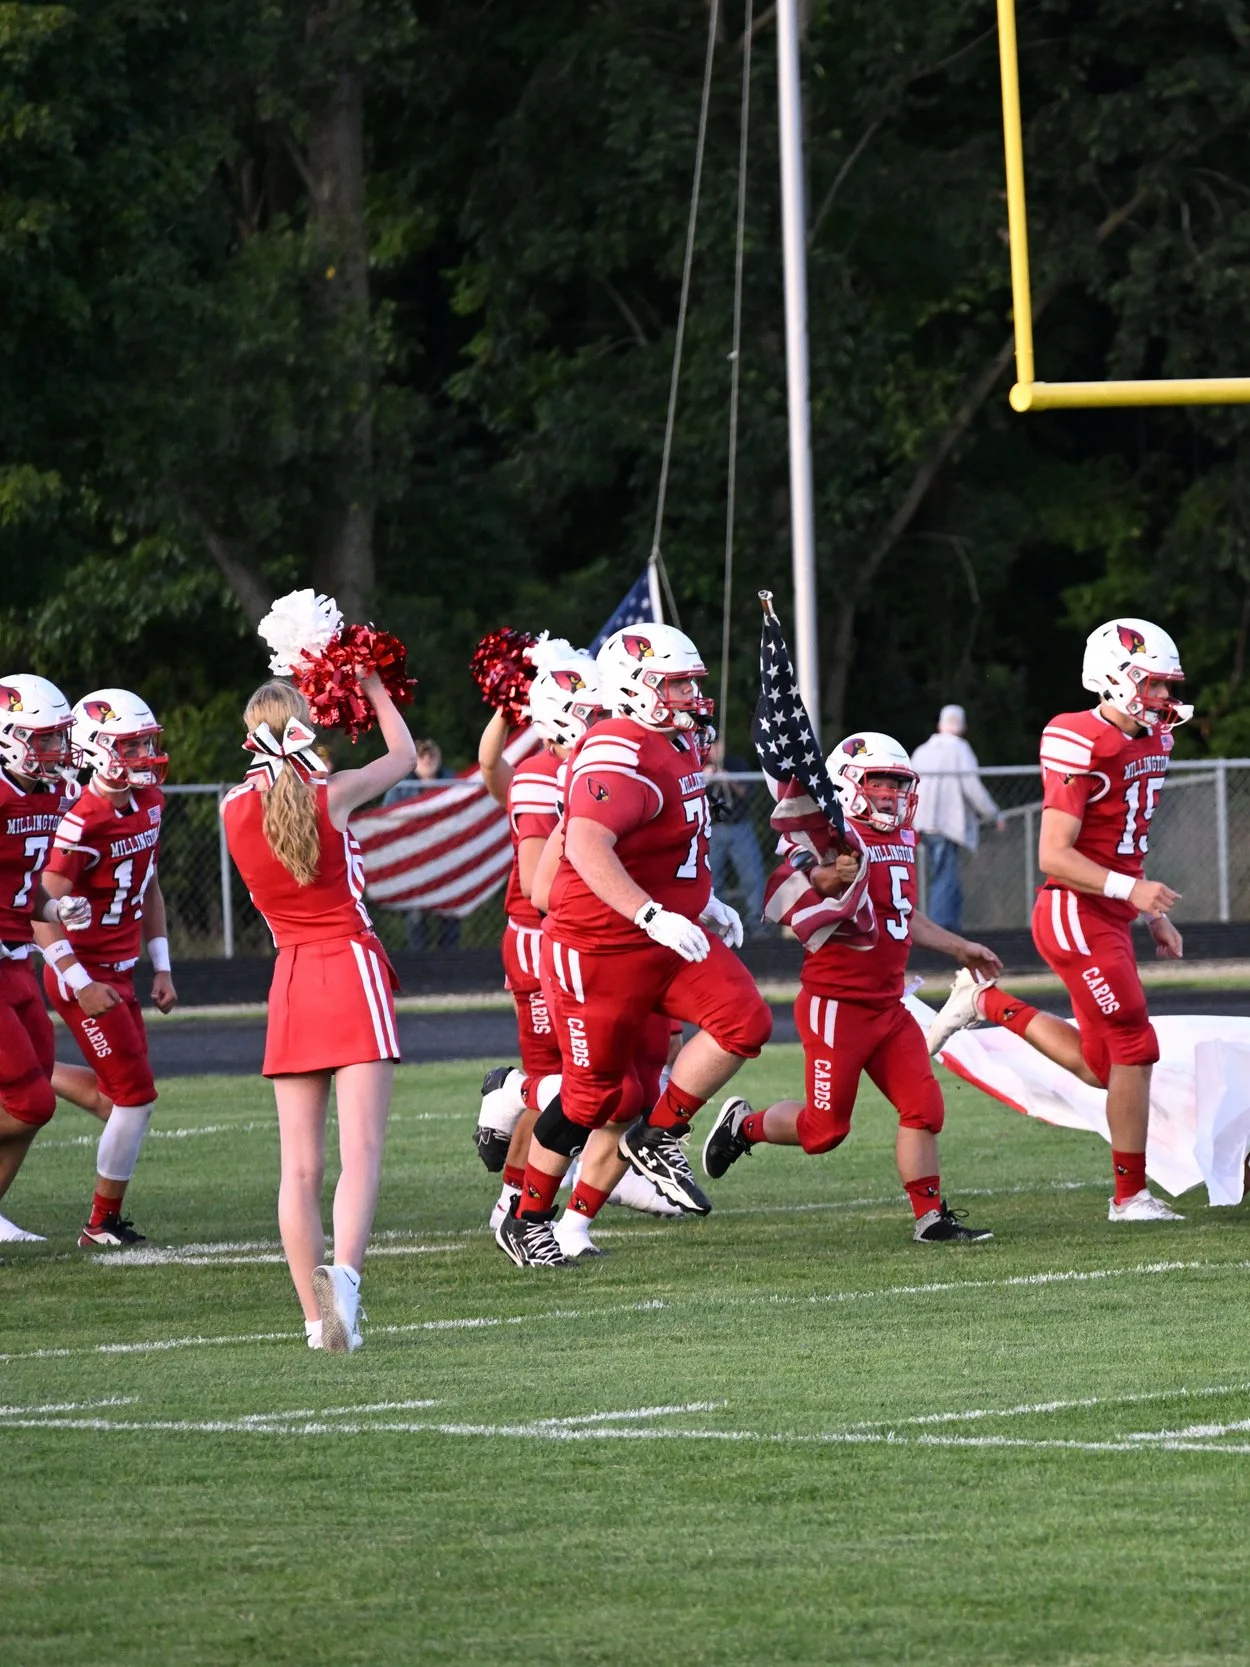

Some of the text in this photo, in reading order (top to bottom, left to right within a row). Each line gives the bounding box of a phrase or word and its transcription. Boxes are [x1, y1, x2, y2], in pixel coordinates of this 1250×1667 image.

[1117, 777, 1166, 854] 15
[110, 827, 158, 858] MILLING
[13, 836, 49, 907] 7
[886, 866, 912, 940] 5
[1081, 966, 1120, 1015] CARDS
[81, 1017, 112, 1058] CARDS
[567, 1017, 590, 1068] CARDS
[814, 1058, 832, 1111] CARDS
